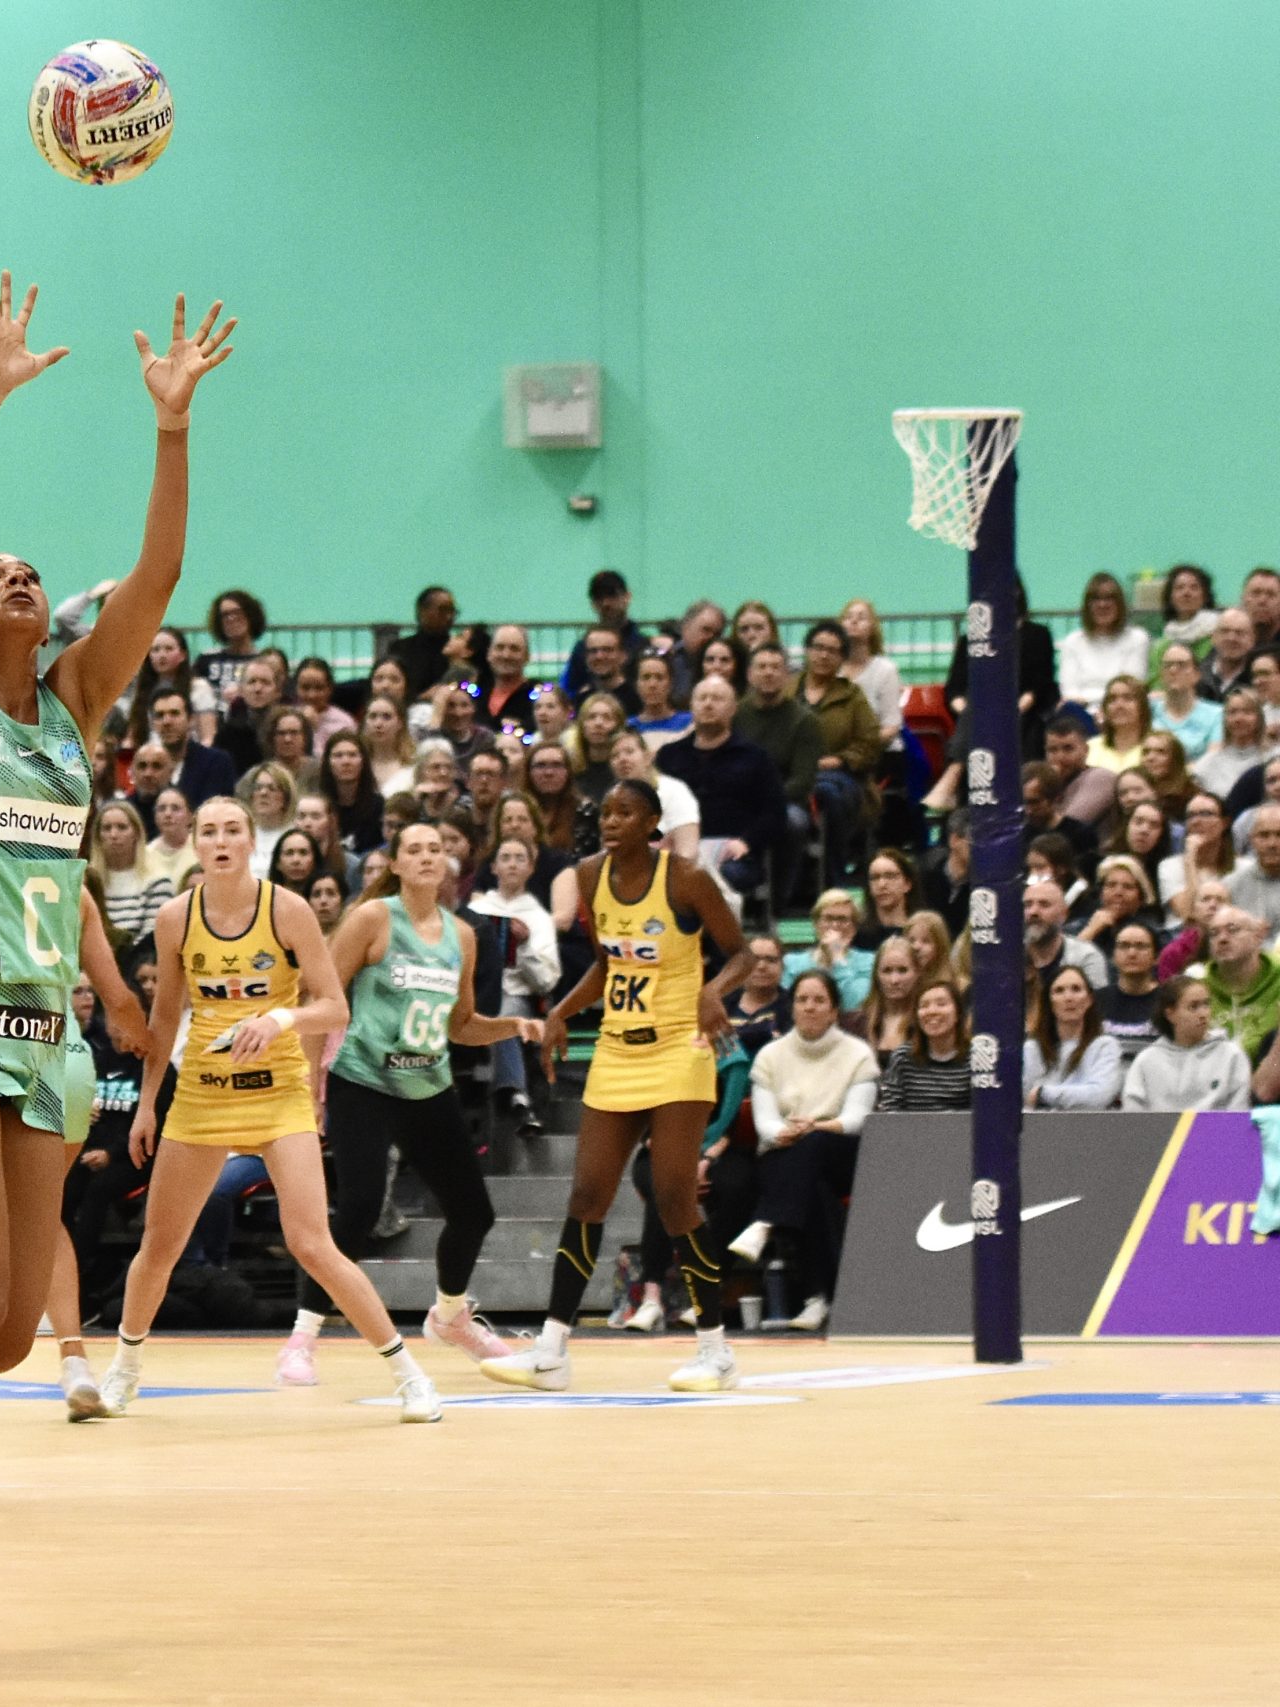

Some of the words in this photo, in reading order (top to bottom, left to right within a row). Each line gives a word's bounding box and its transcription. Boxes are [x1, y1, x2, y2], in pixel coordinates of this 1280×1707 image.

[86, 105, 172, 145] GILBERT
[23, 876, 61, 966] C
[609, 974, 650, 1013] GK
[403, 999, 452, 1051] GS
[199, 1072, 229, 1089] sky
[236, 1073, 269, 1087] bet
